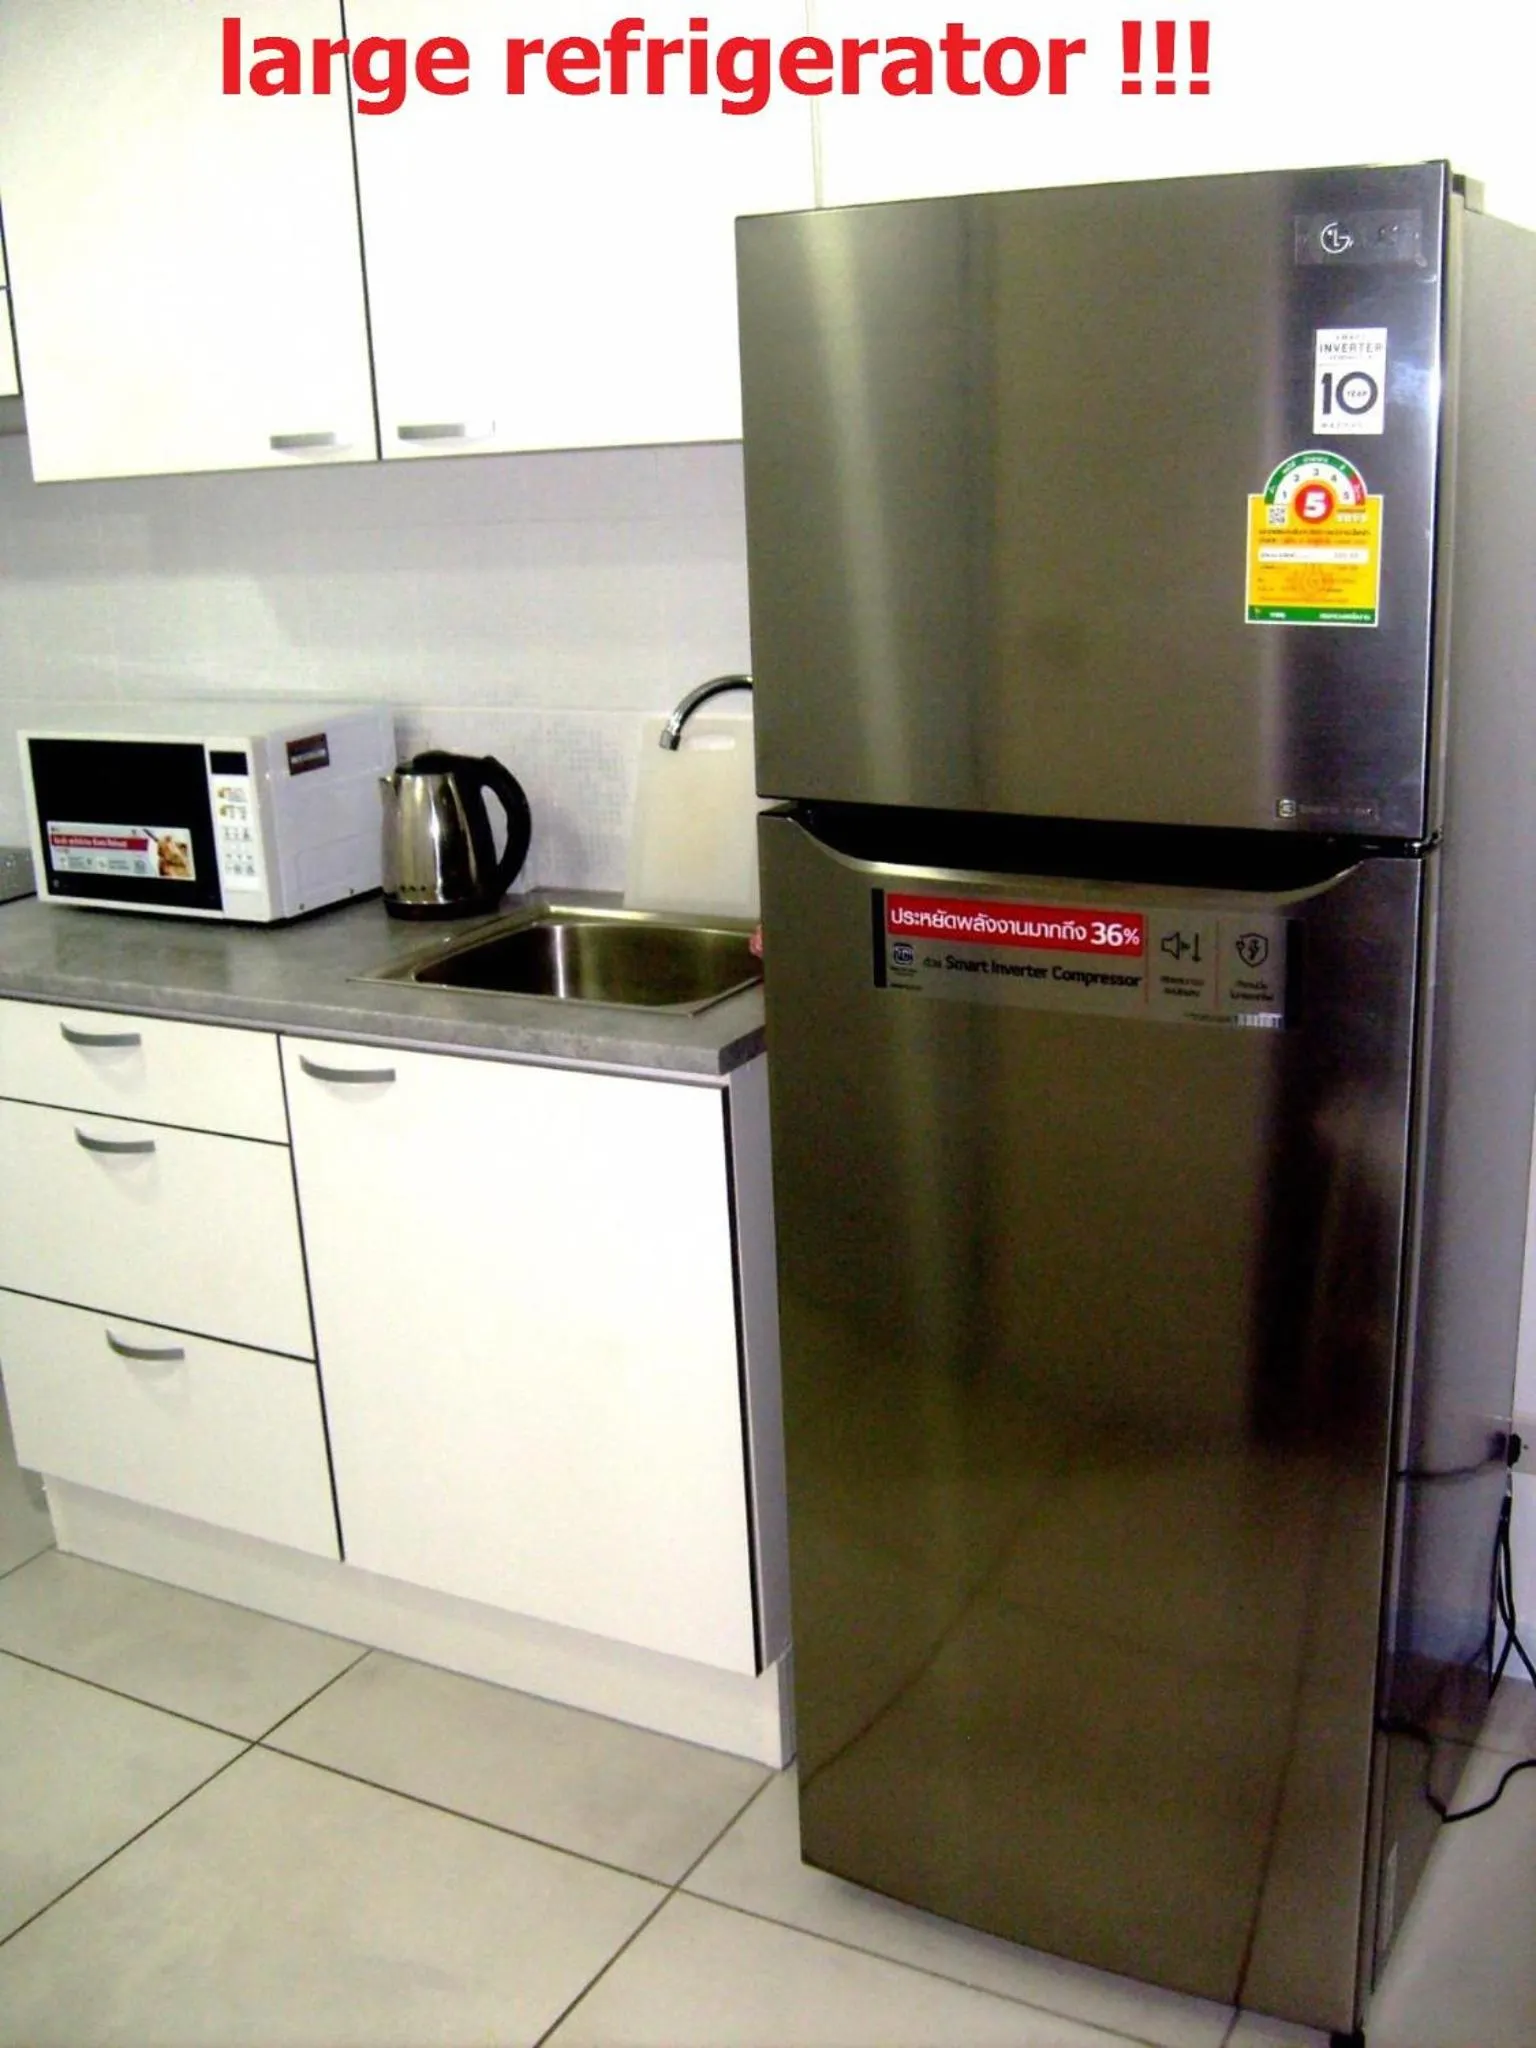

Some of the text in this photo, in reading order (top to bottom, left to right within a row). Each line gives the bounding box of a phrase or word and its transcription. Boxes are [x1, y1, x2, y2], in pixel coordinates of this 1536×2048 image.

[1320, 343, 1383, 353] INVERTER
[1321, 371, 1378, 415] 10
[1303, 491, 1326, 518] 5
[890, 907, 1140, 946] ประหยัดพลังงานมากถึง 36%
[945, 954, 988, 974] Smart
[991, 961, 1048, 979] Inverter
[1052, 966, 1142, 987] Compressor
